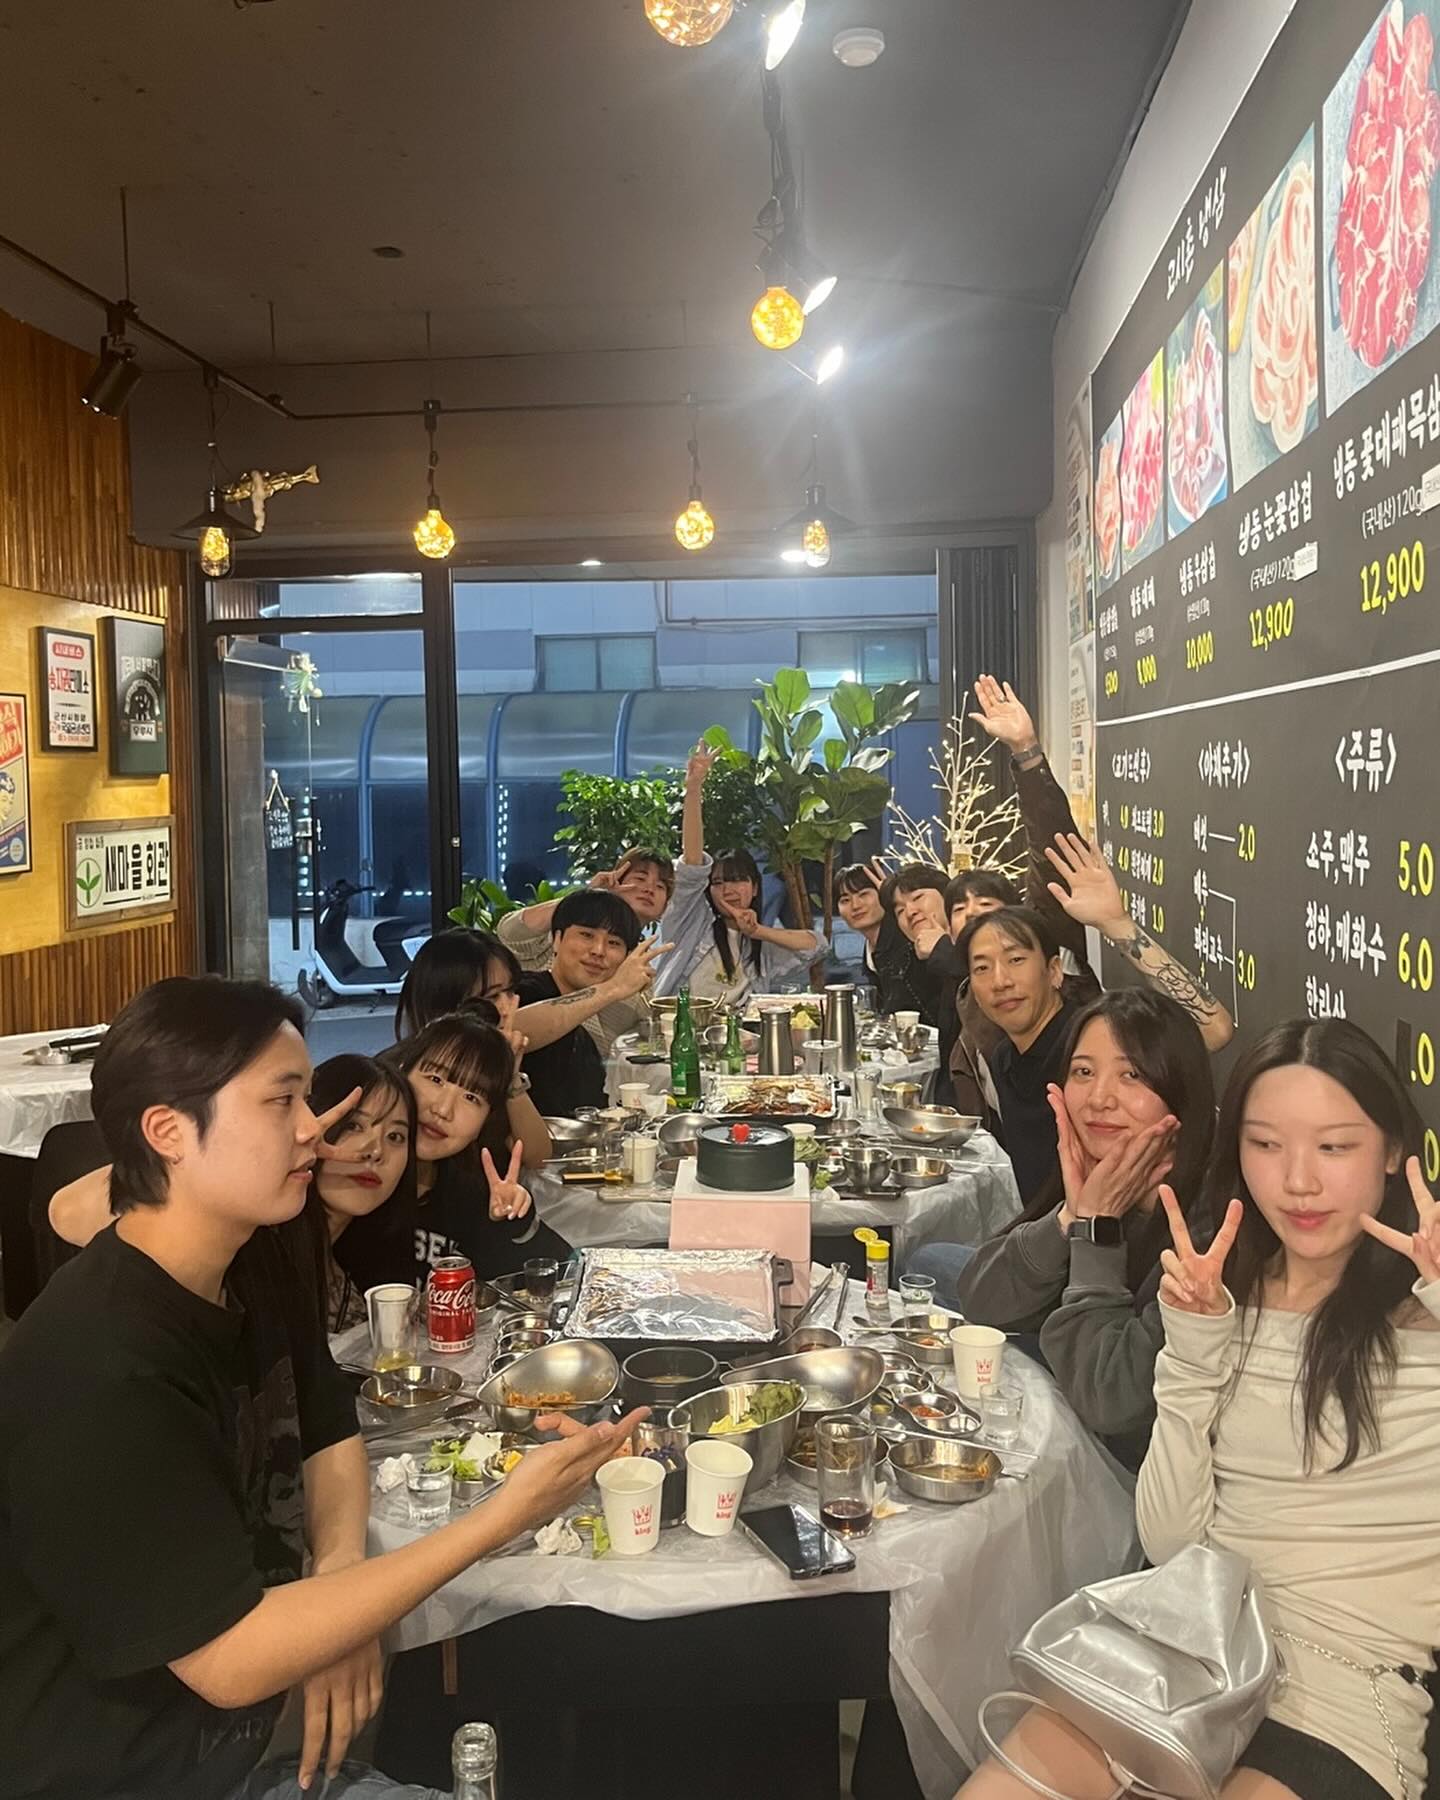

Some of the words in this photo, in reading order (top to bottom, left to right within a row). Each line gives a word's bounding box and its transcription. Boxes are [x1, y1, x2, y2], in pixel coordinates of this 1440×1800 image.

[1360, 540, 1424, 616] 12,900
[1249, 587, 1294, 652] 12,900
[1186, 630, 1214, 672] 10,000
[1238, 822, 1255, 862] 2.0
[1306, 829, 1371, 888] 소주,맥주
[1398, 839, 1435, 897] 5.0
[1237, 949, 1255, 990] 3.0
[1306, 900, 1388, 977] 청하,매화수
[1398, 931, 1434, 993] 6.0
[635, 1527, 651, 1535] king
